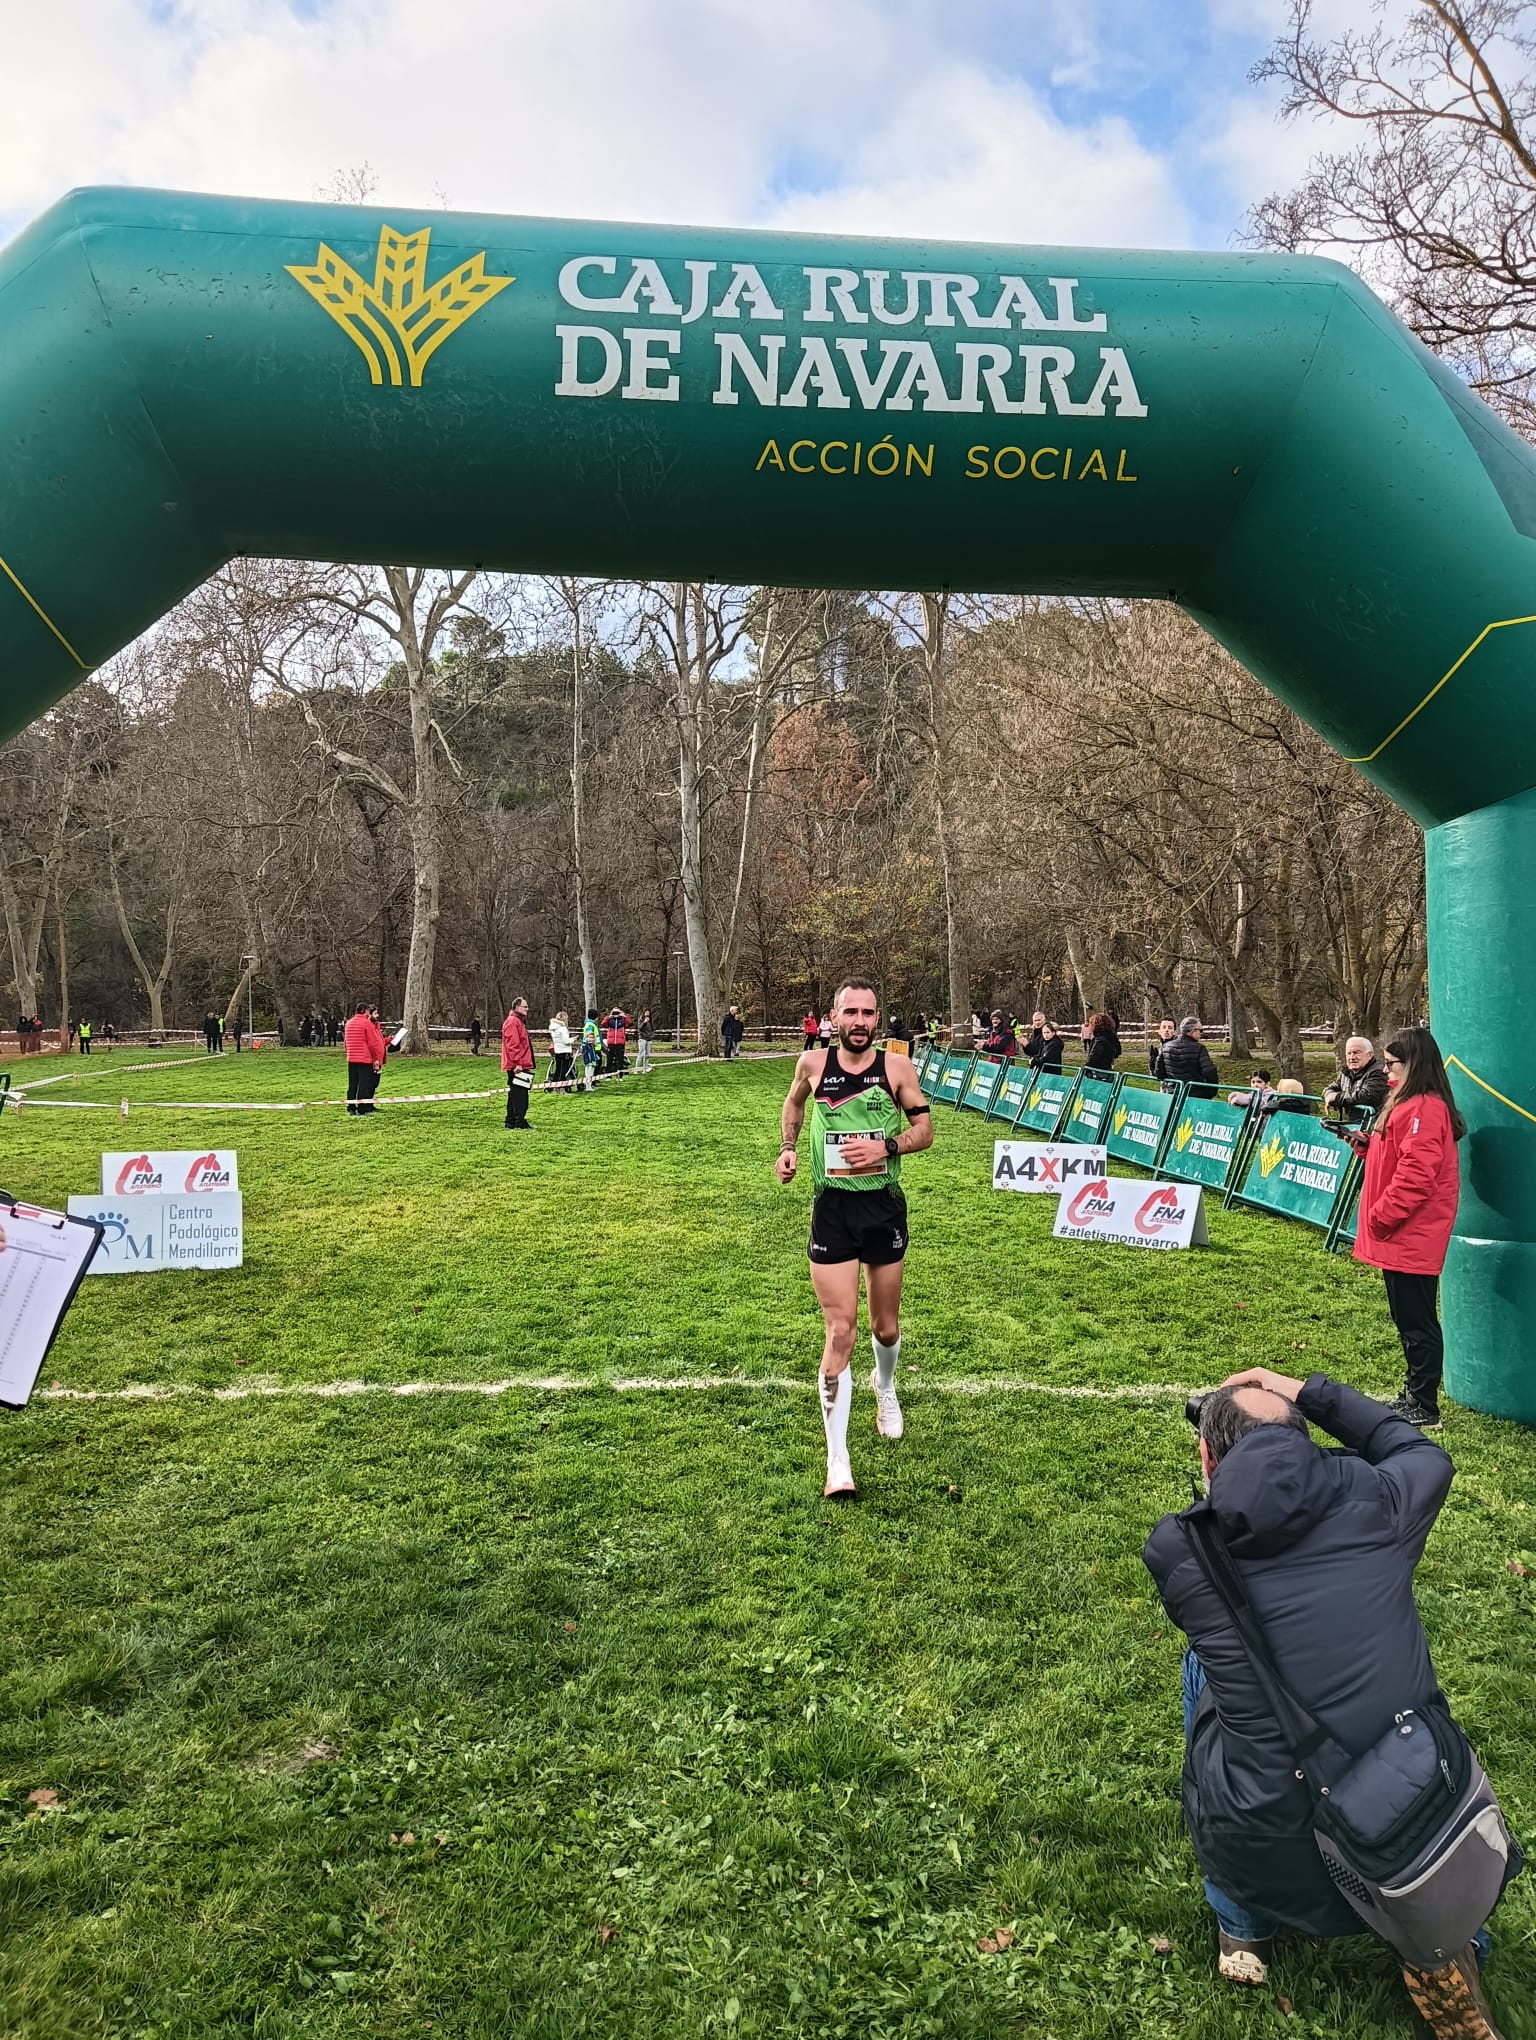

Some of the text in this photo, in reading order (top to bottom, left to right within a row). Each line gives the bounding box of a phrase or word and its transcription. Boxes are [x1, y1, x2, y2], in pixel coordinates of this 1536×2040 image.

[557, 255, 1108, 332] CAJA RURAL
[554, 324, 1149, 418] DE NAVARRA
[755, 433, 1139, 483] ACCIÓN SOCIAL
[1287, 1141, 1342, 1169] CAJA RURAL
[132, 1173, 162, 1185] FNA
[201, 1171, 230, 1183] FNA
[994, 1154, 1106, 1183] A4XKM
[1279, 1161, 1338, 1194] DE NAVARRA
[169, 1204, 213, 1219] Centro
[1084, 1199, 1116, 1213] FNA
[1153, 1206, 1186, 1221] FNA
[169, 1223, 238, 1241] Podológico
[1059, 1225, 1180, 1249] #atletismonavarro
[169, 1243, 238, 1259] Mendillorri
